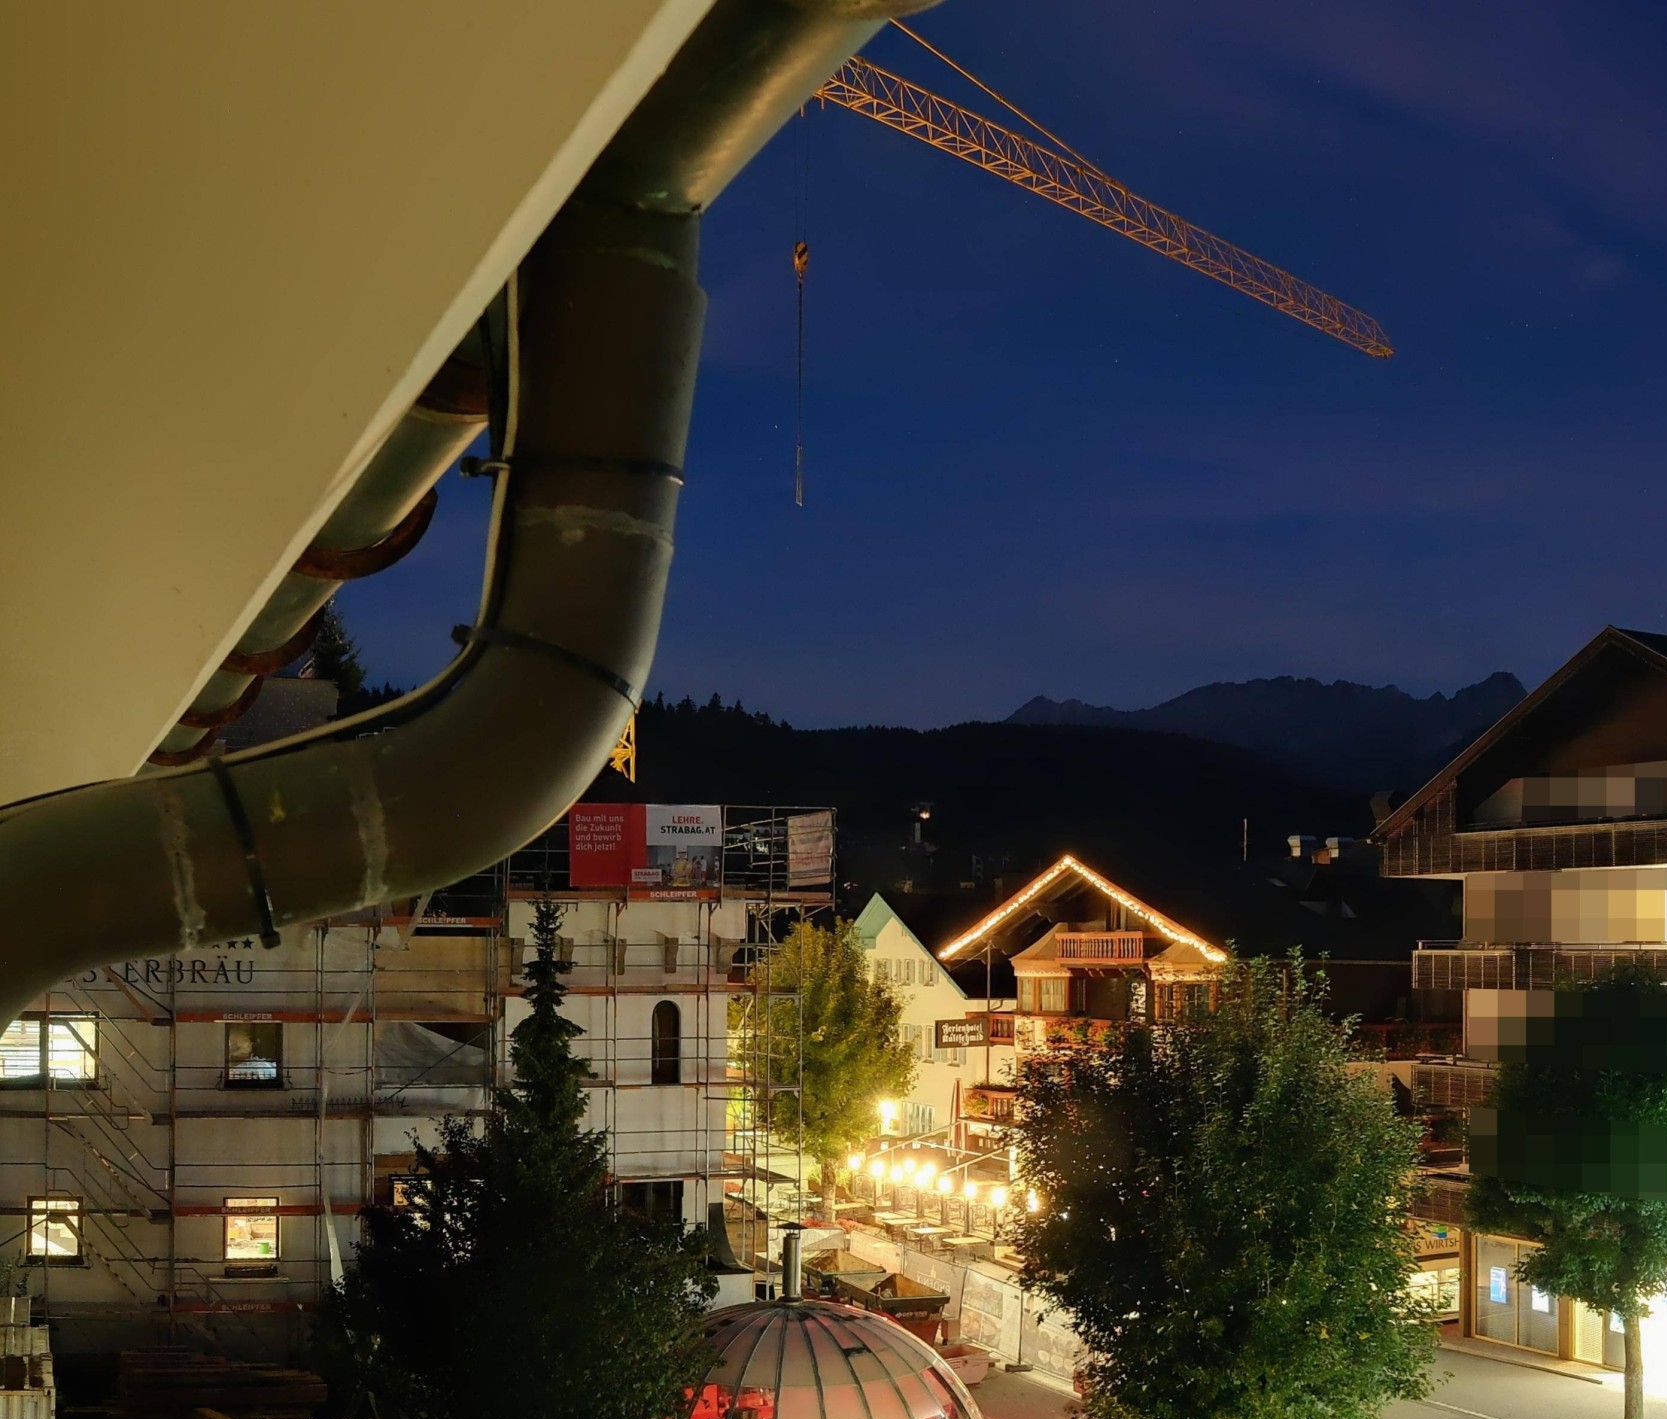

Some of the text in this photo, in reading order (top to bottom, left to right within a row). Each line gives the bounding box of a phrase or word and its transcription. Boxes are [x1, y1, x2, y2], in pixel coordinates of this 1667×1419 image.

[575, 814, 593, 822] Bau
[593, 814, 608, 822] mit
[672, 816, 704, 824] LEHRE.
[660, 826, 716, 834] STRABAG.AT
[575, 833, 622, 841] und bewirb
[594, 843, 616, 852] jetzt!
